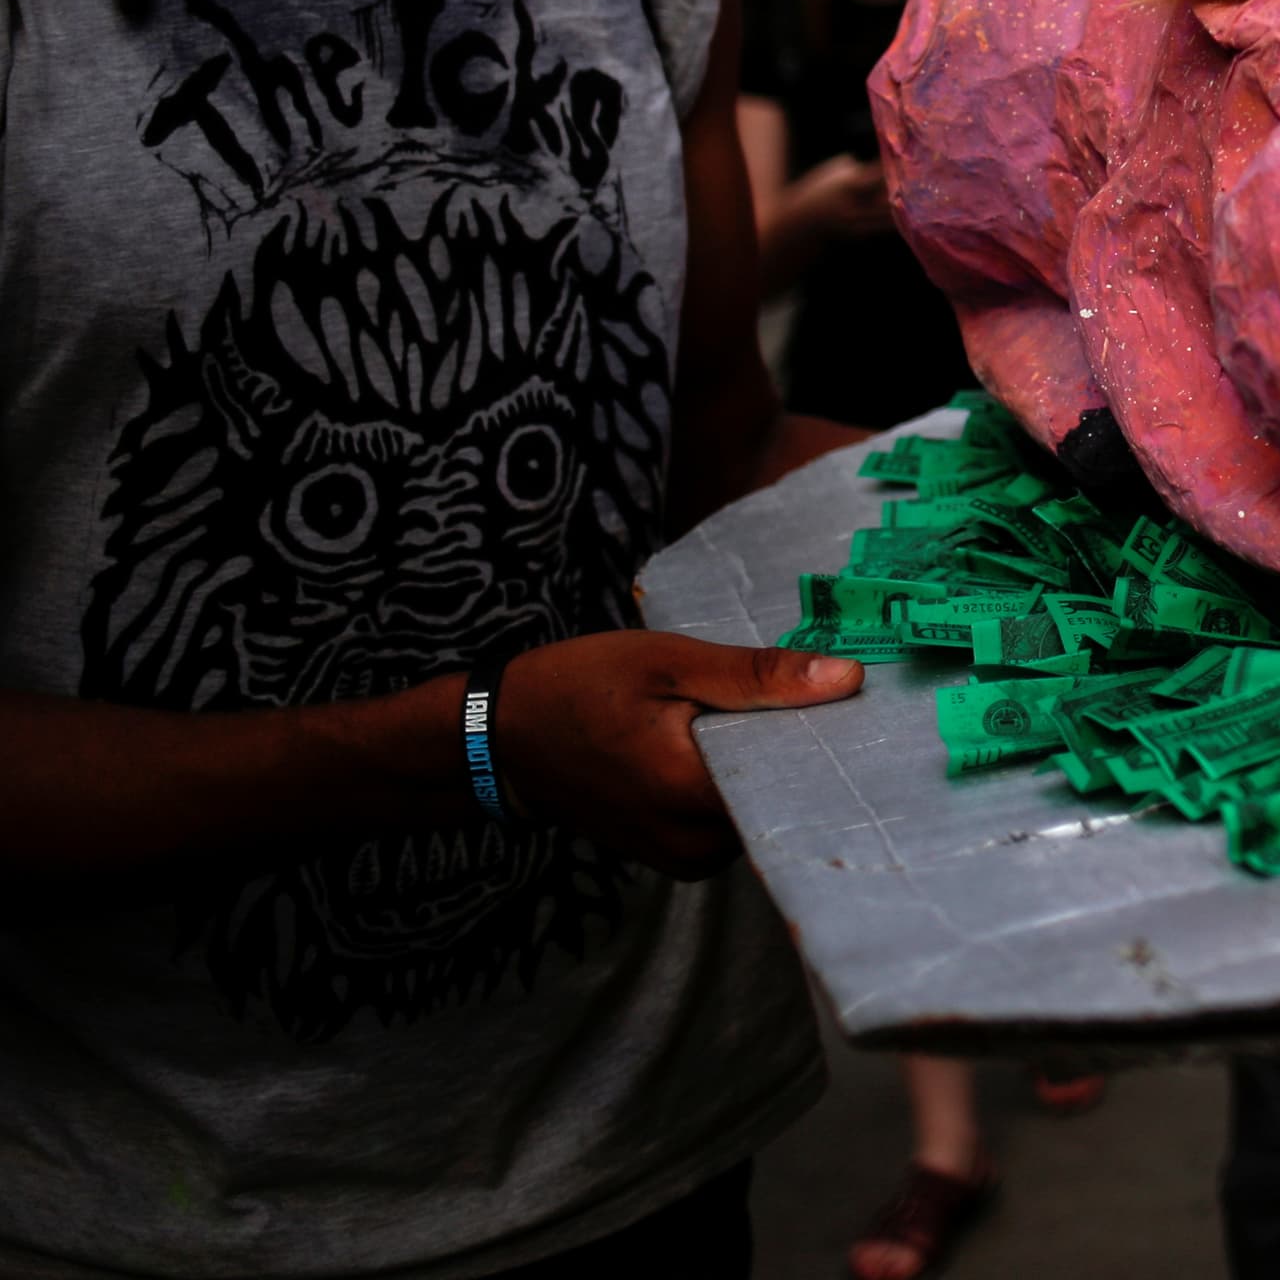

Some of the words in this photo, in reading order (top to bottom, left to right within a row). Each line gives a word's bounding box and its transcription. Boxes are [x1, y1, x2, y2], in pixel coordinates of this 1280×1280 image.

[467, 691, 490, 699] I
[465, 699, 489, 733] AM
[465, 733, 493, 773] NOT
